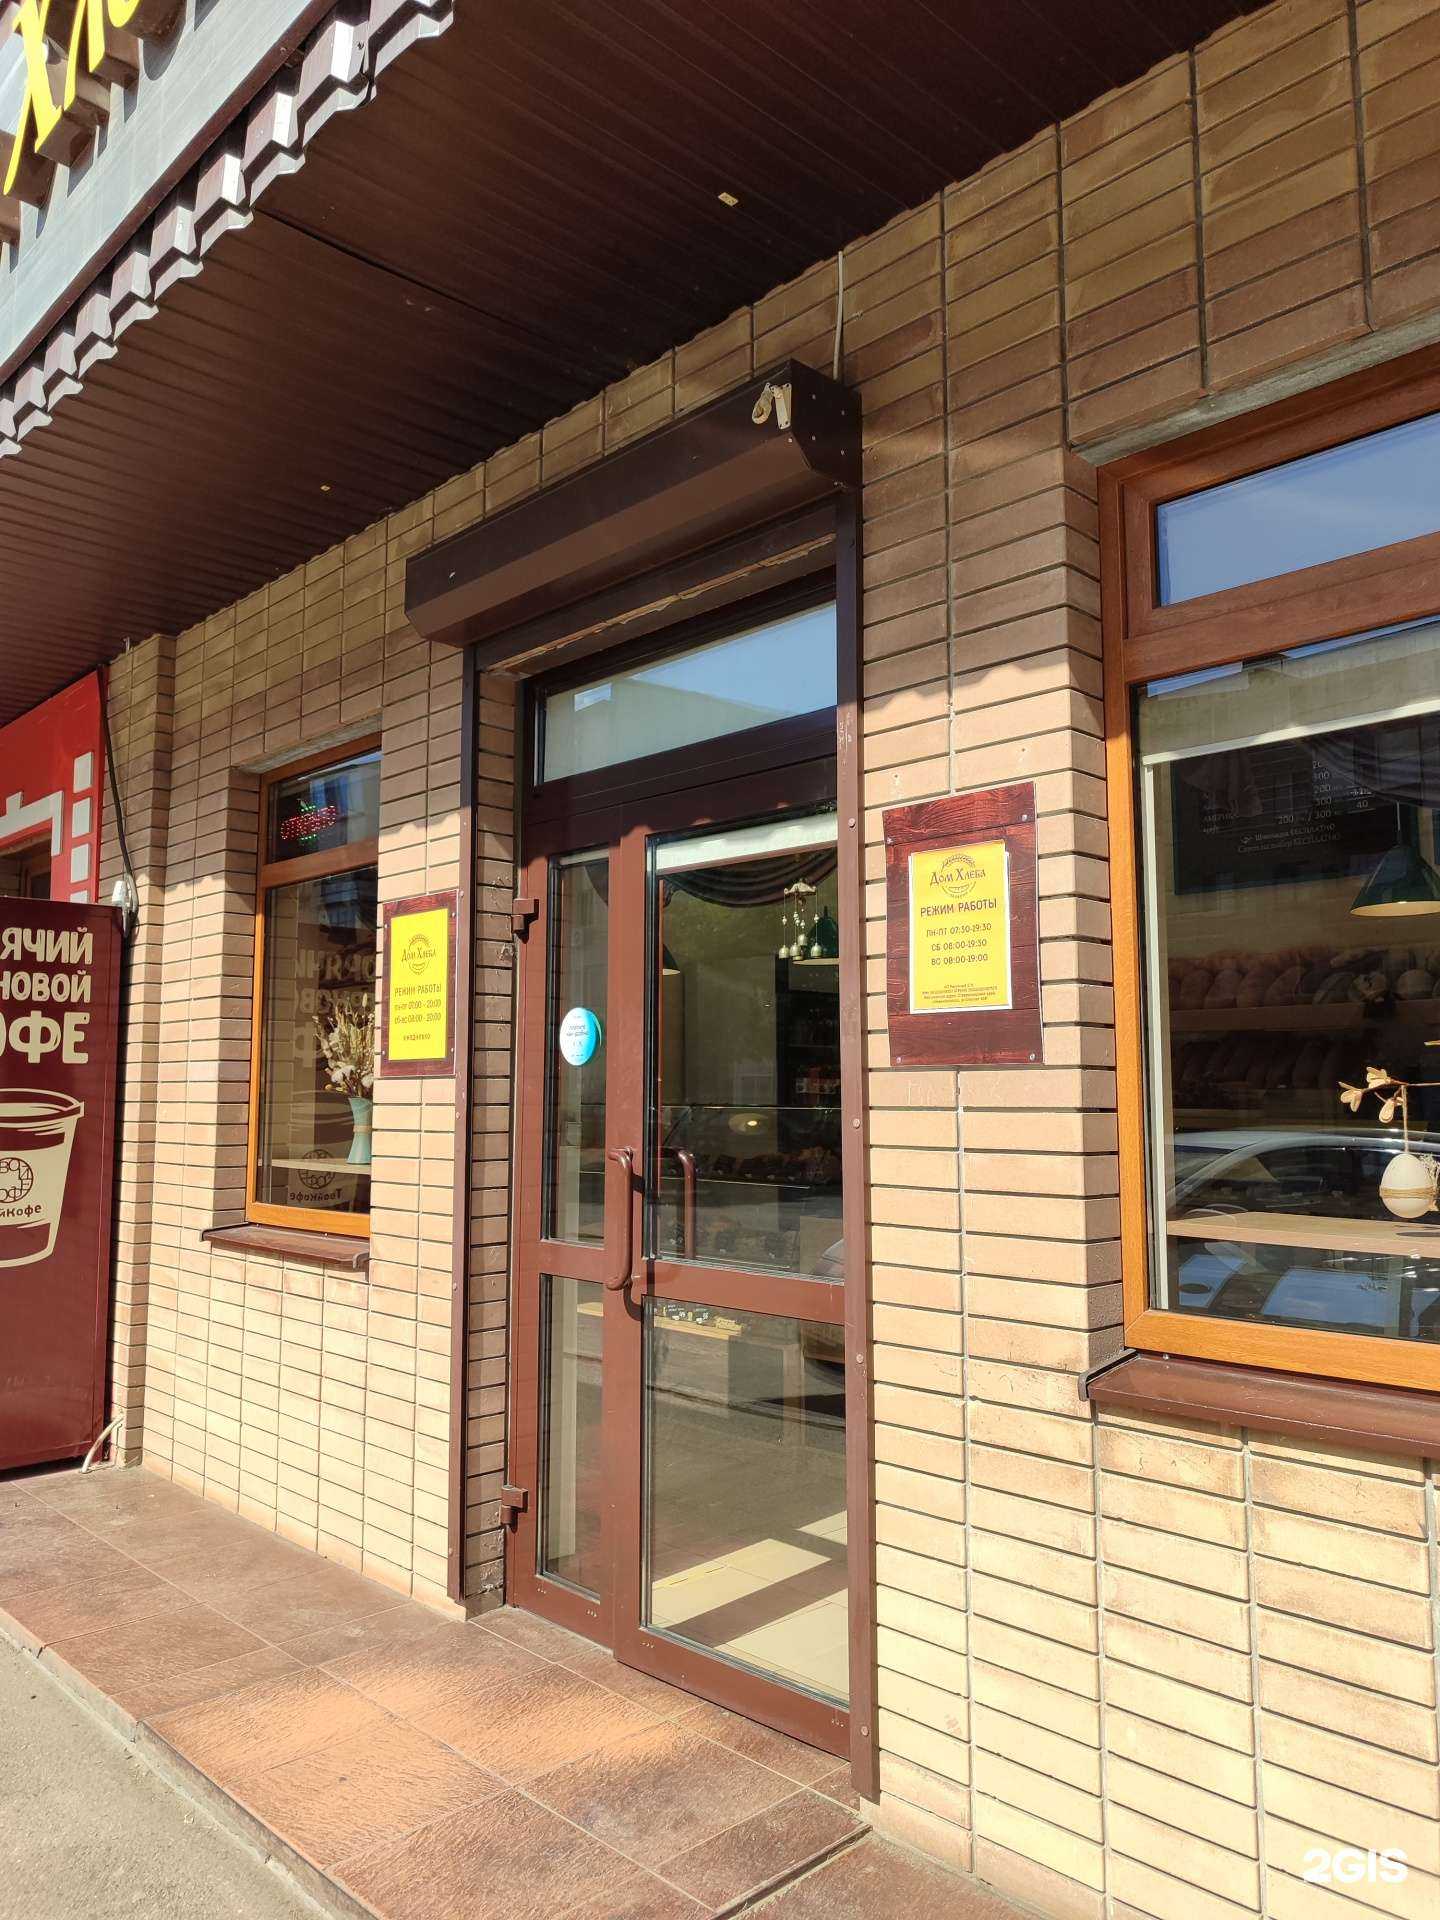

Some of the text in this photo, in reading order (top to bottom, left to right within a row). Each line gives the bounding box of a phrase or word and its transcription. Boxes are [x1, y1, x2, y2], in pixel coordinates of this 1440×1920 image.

[920, 898, 997, 917] РЕЖИМ РАБОТЫ
[0, 926, 94, 965] ЯЧИЙ
[394, 983, 442, 998] РЕЖИМ РАБОТЫ
[0, 1010, 90, 1064] ФЕ
